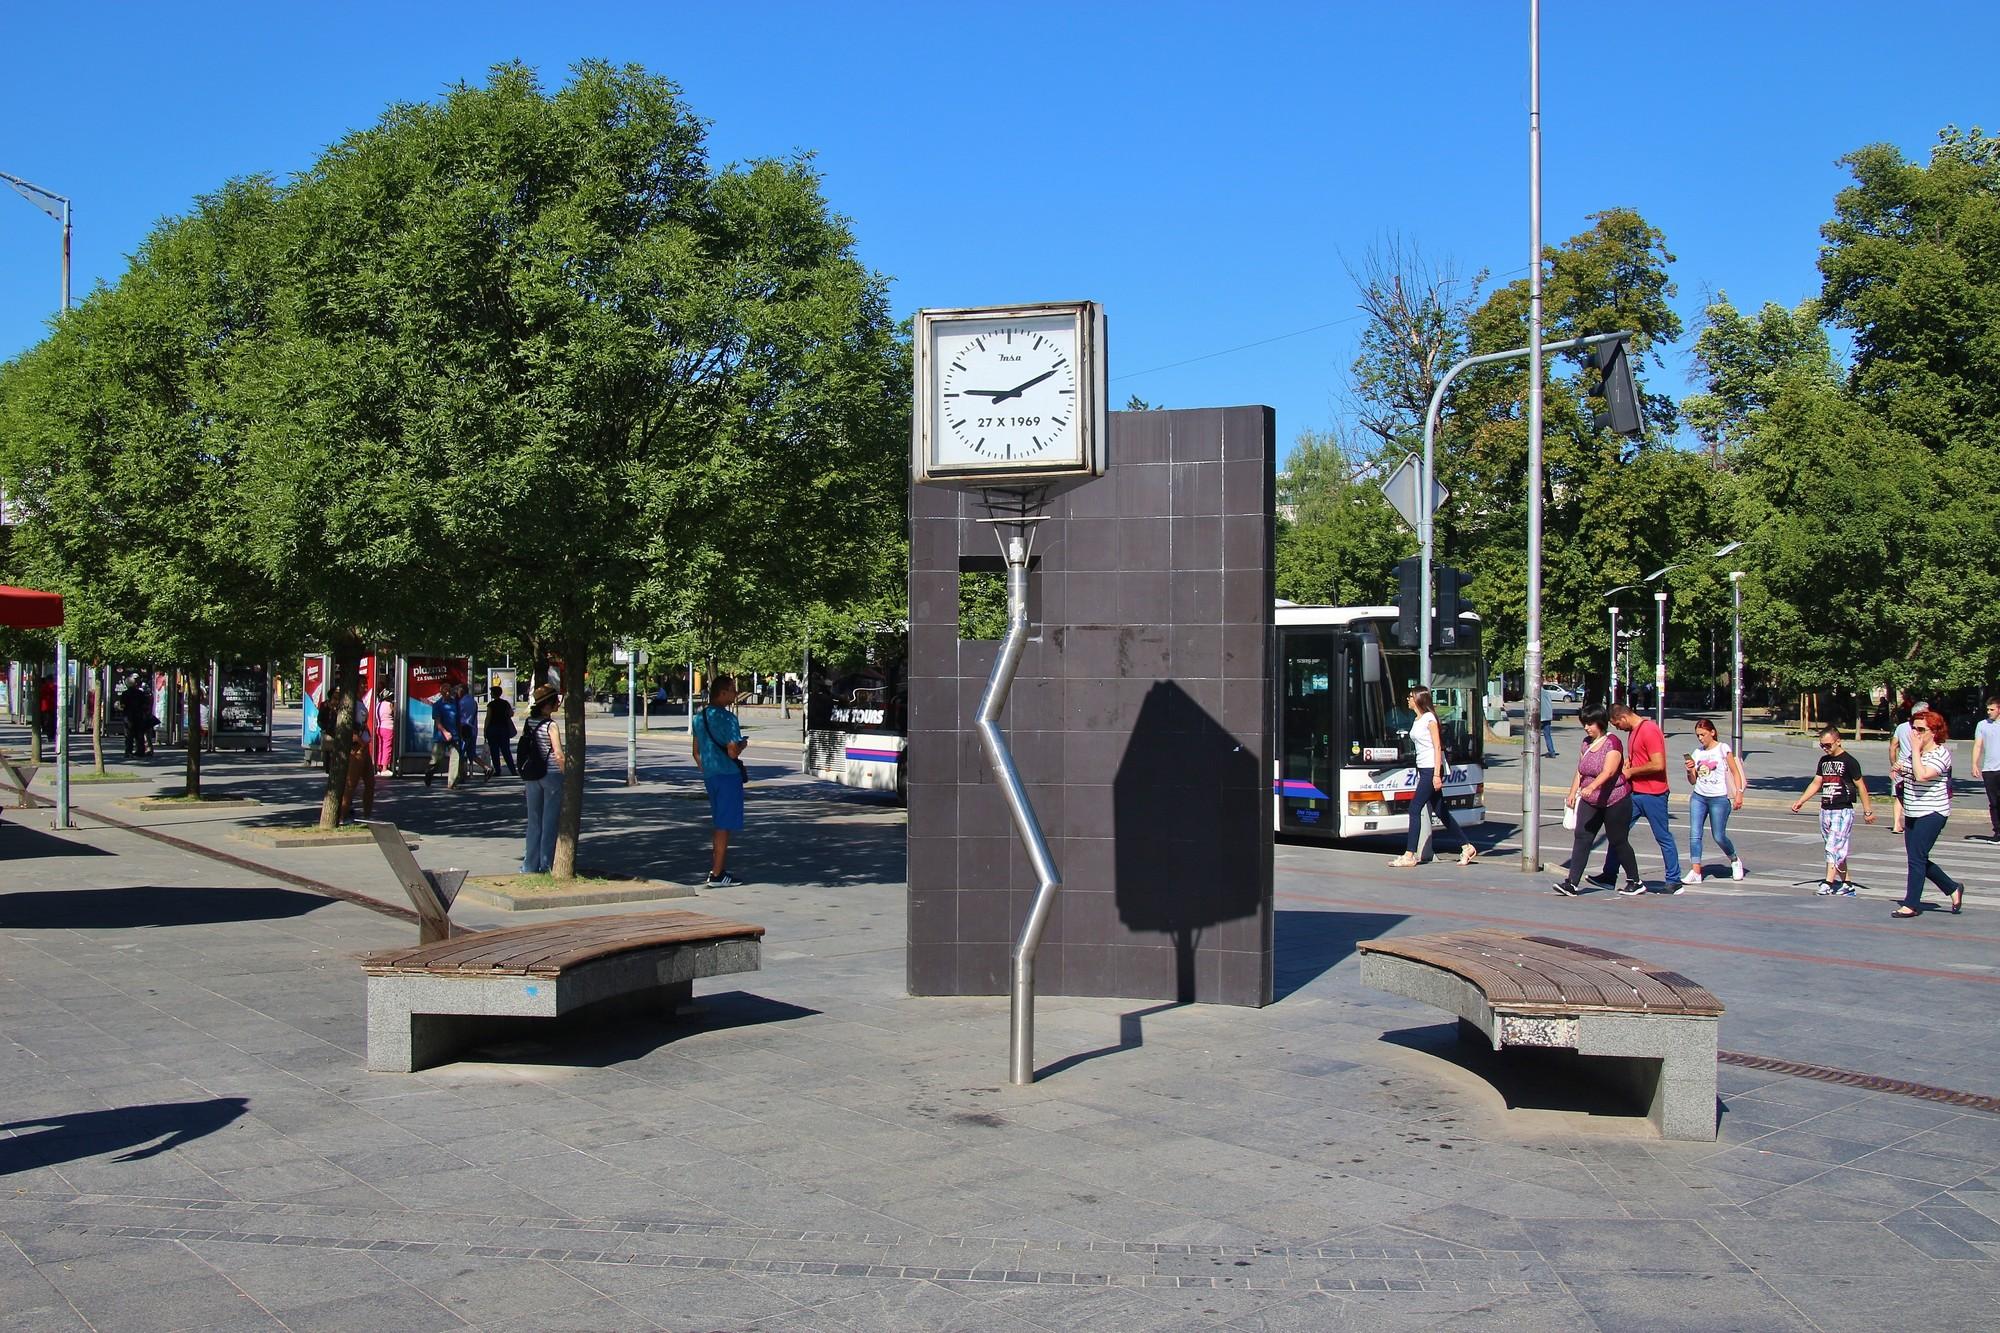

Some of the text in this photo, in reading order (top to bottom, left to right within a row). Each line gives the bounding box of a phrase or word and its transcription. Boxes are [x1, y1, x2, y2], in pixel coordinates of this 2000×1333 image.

[977, 416, 1041, 428] 27 X 1969
[852, 709, 884, 724] TOURS
[1365, 749, 1373, 761] 8
